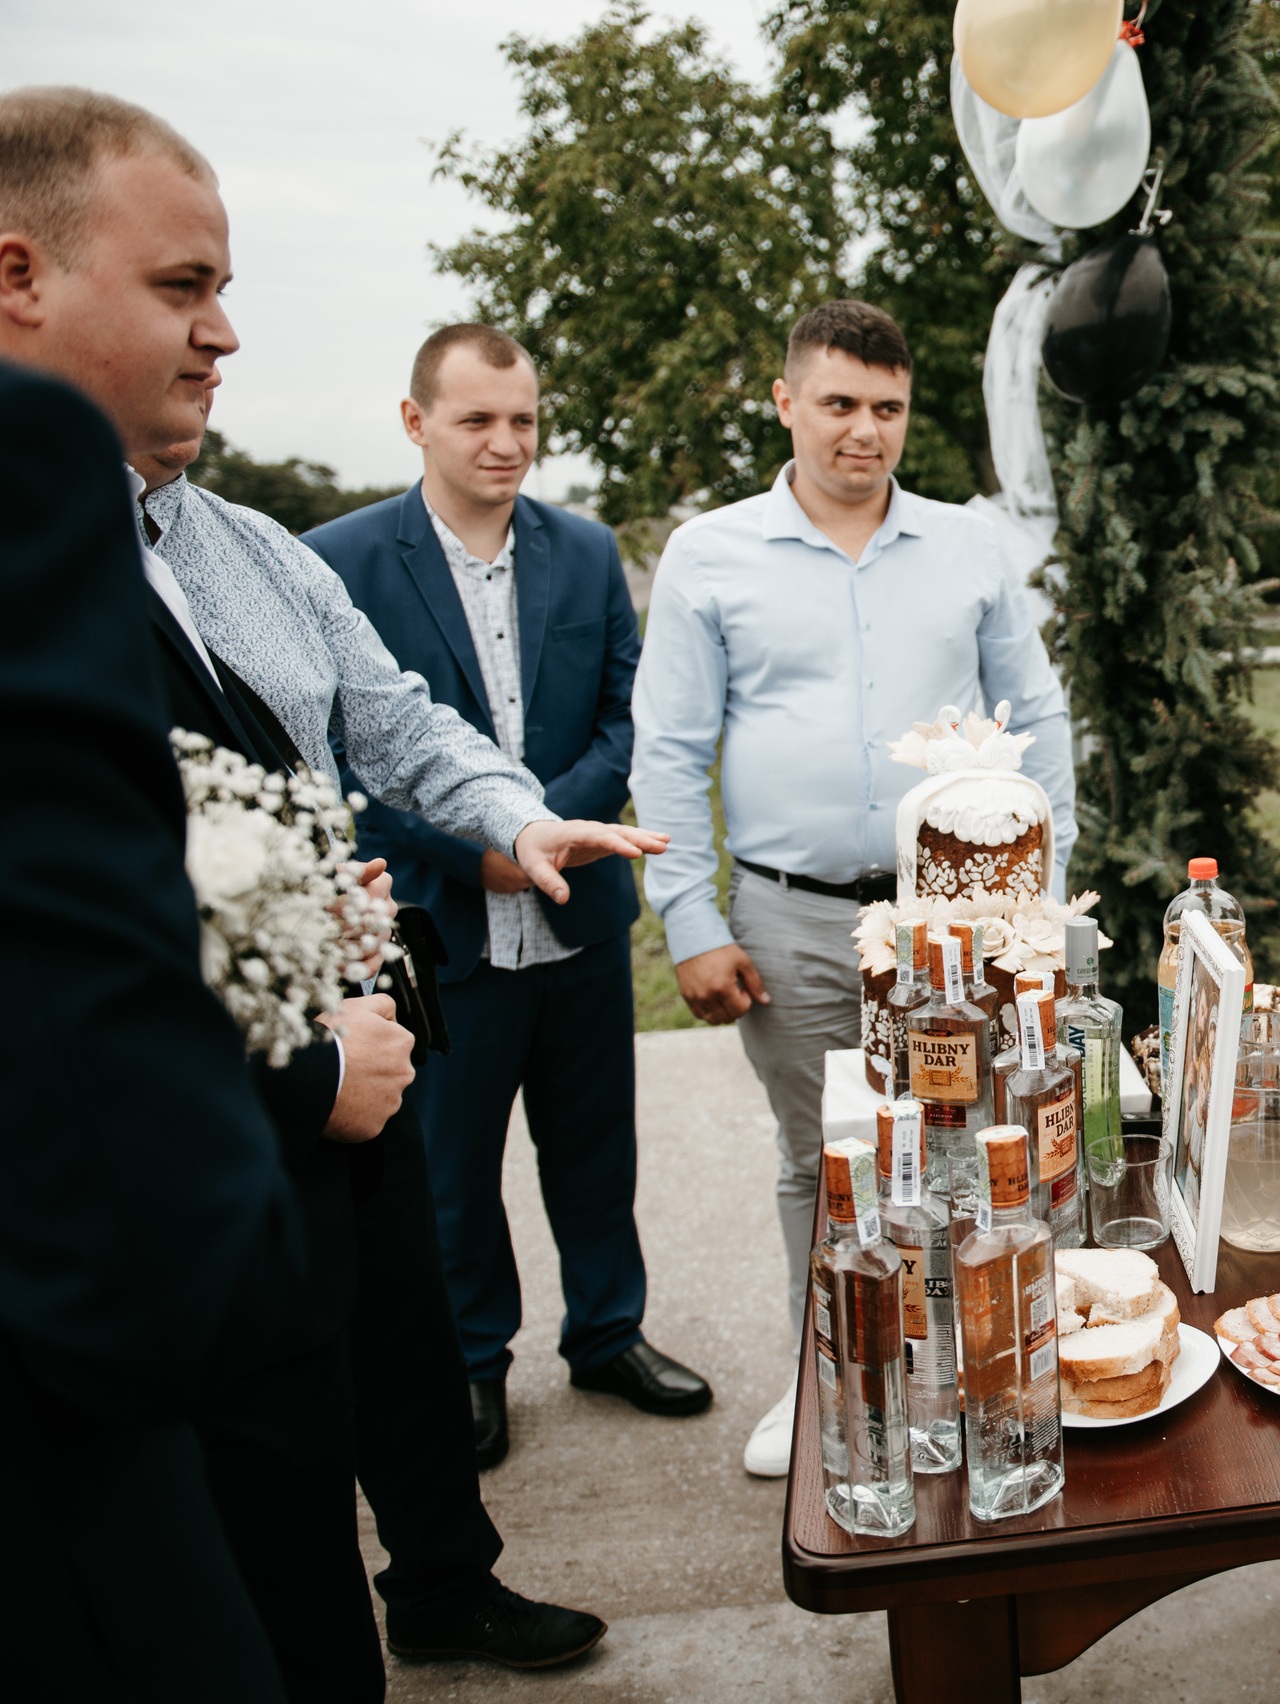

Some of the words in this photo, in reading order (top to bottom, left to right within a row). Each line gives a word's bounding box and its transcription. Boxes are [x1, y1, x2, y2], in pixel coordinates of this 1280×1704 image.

[912, 1040, 970, 1055] HLIBNY
[924, 1054, 956, 1067] DAR
[1056, 1115, 1074, 1138] DAR
